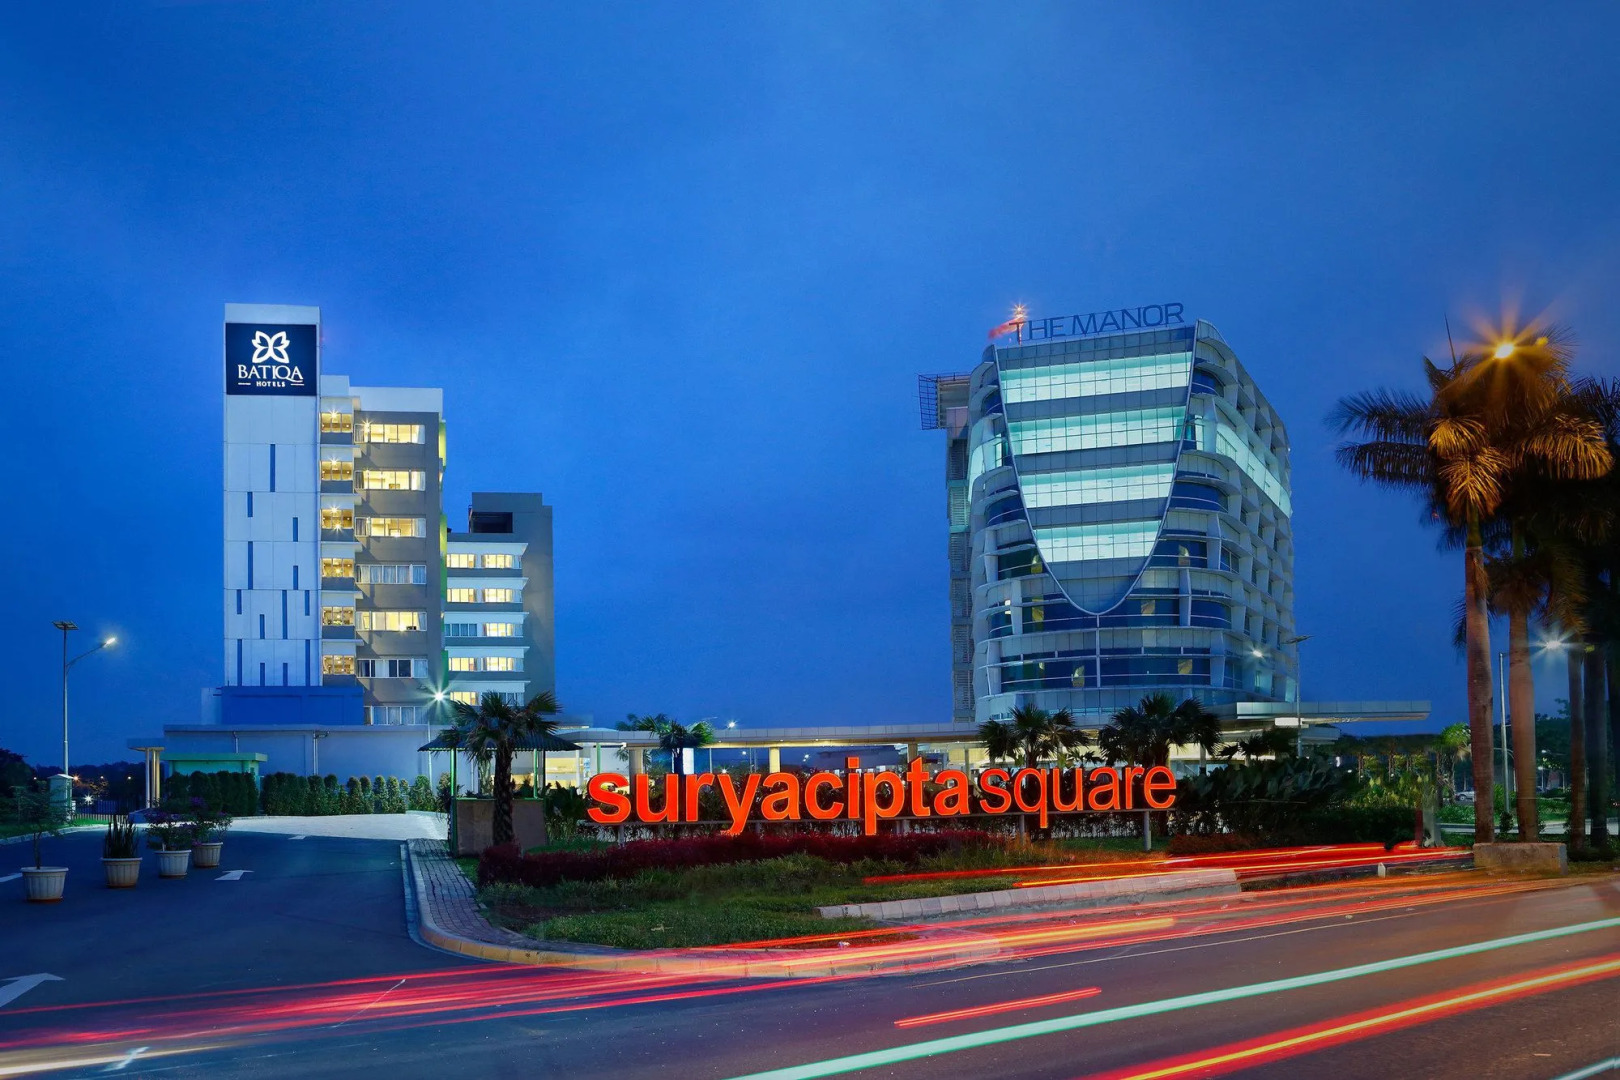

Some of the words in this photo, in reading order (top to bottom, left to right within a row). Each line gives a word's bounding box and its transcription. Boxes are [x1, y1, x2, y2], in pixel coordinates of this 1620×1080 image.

[1009, 316, 1066, 344] THE
[1072, 302, 1184, 336] MANOR
[238, 364, 303, 382] BATIQA
